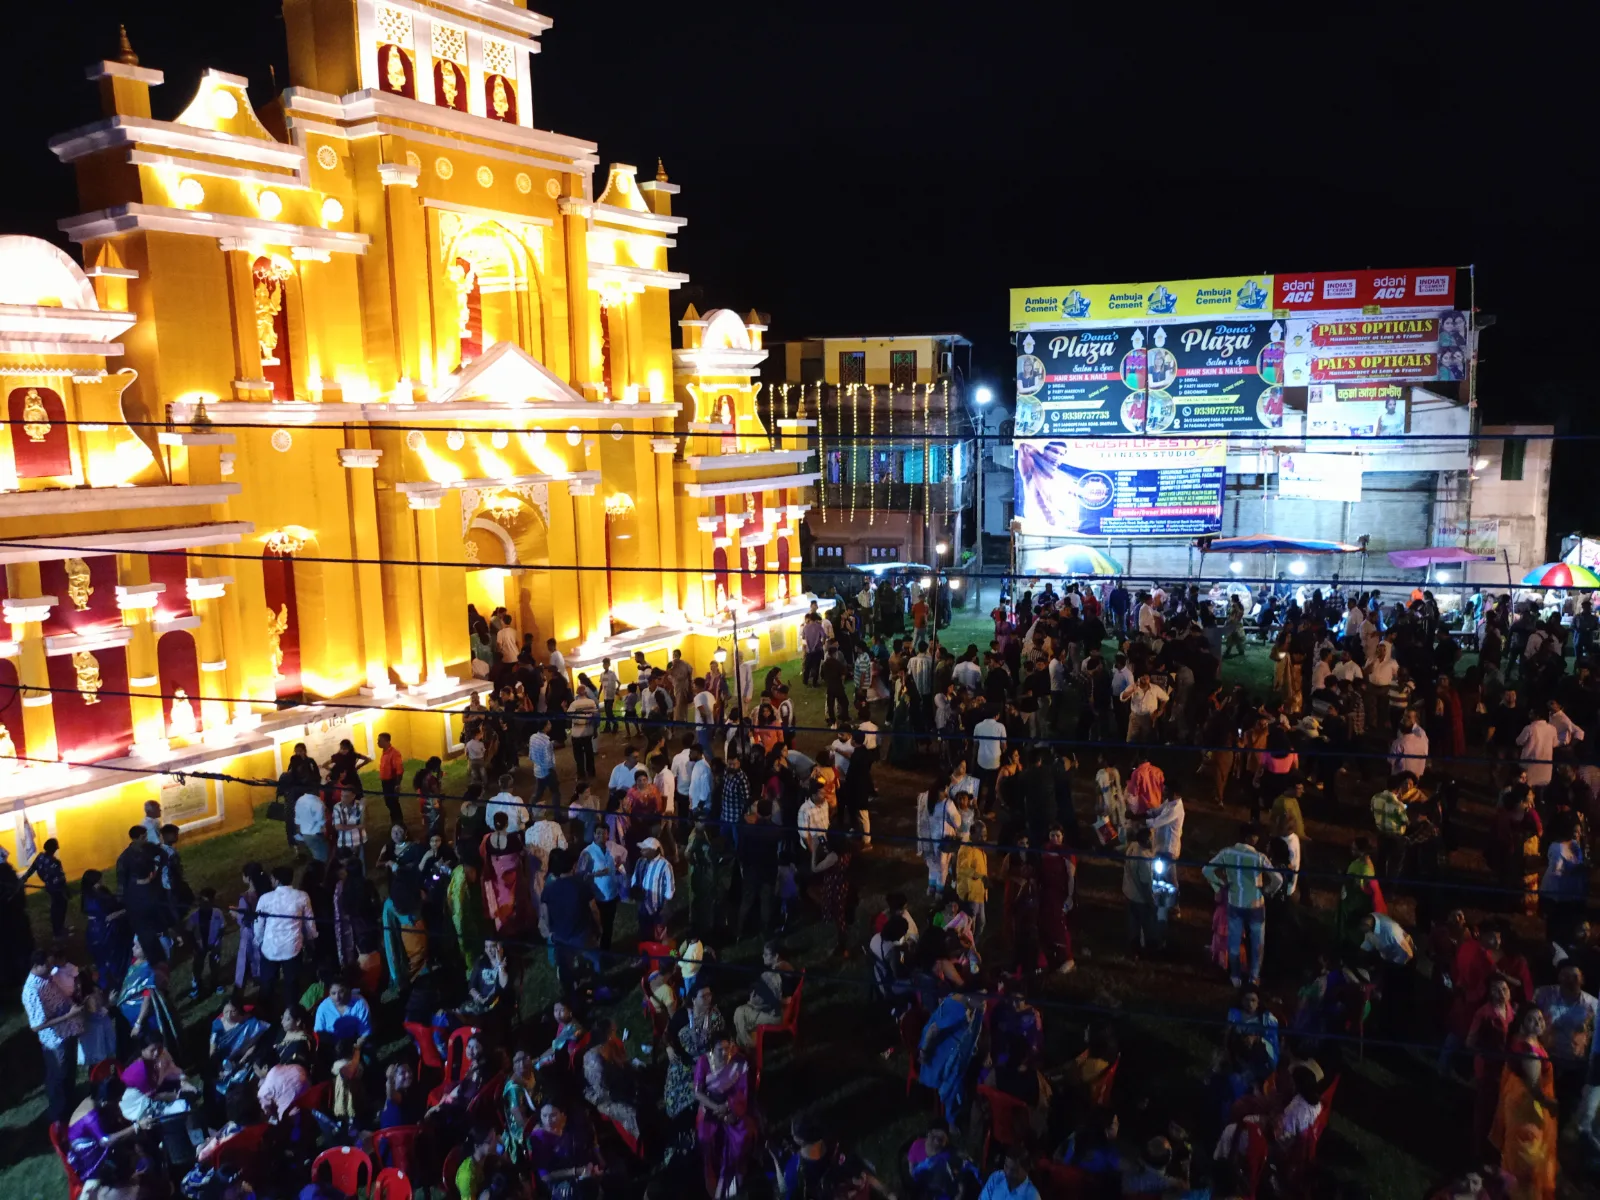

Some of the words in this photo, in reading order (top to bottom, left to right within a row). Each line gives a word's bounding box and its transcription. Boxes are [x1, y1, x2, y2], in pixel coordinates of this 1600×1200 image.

[1282, 279, 1314, 291] adani
[1373, 275, 1406, 287] adani
[1109, 293, 1143, 303] Ambuja
[1196, 288, 1231, 298] Ambuja
[1282, 291, 1314, 303] ACC
[1373, 288, 1406, 300] ACC
[1025, 297, 1058, 306] Ambuja
[1108, 301, 1143, 310] Cement
[1196, 296, 1231, 306] Cement
[1025, 304, 1058, 313] Cement
[1215, 324, 1256, 334] Dona's
[1319, 324, 1357, 336] PAL'S
[1362, 320, 1432, 334] OPTICALS
[1080, 332, 1119, 341] Dona's
[1181, 328, 1252, 358] Plaza
[1049, 336, 1116, 364] Plaza
[1206, 358, 1226, 366] Salon
[1235, 357, 1250, 366] Spa
[1318, 358, 1356, 370] PAL'S
[1361, 354, 1431, 369] OPTICALS
[1073, 364, 1092, 372] Salon
[1100, 363, 1114, 373] Spa
